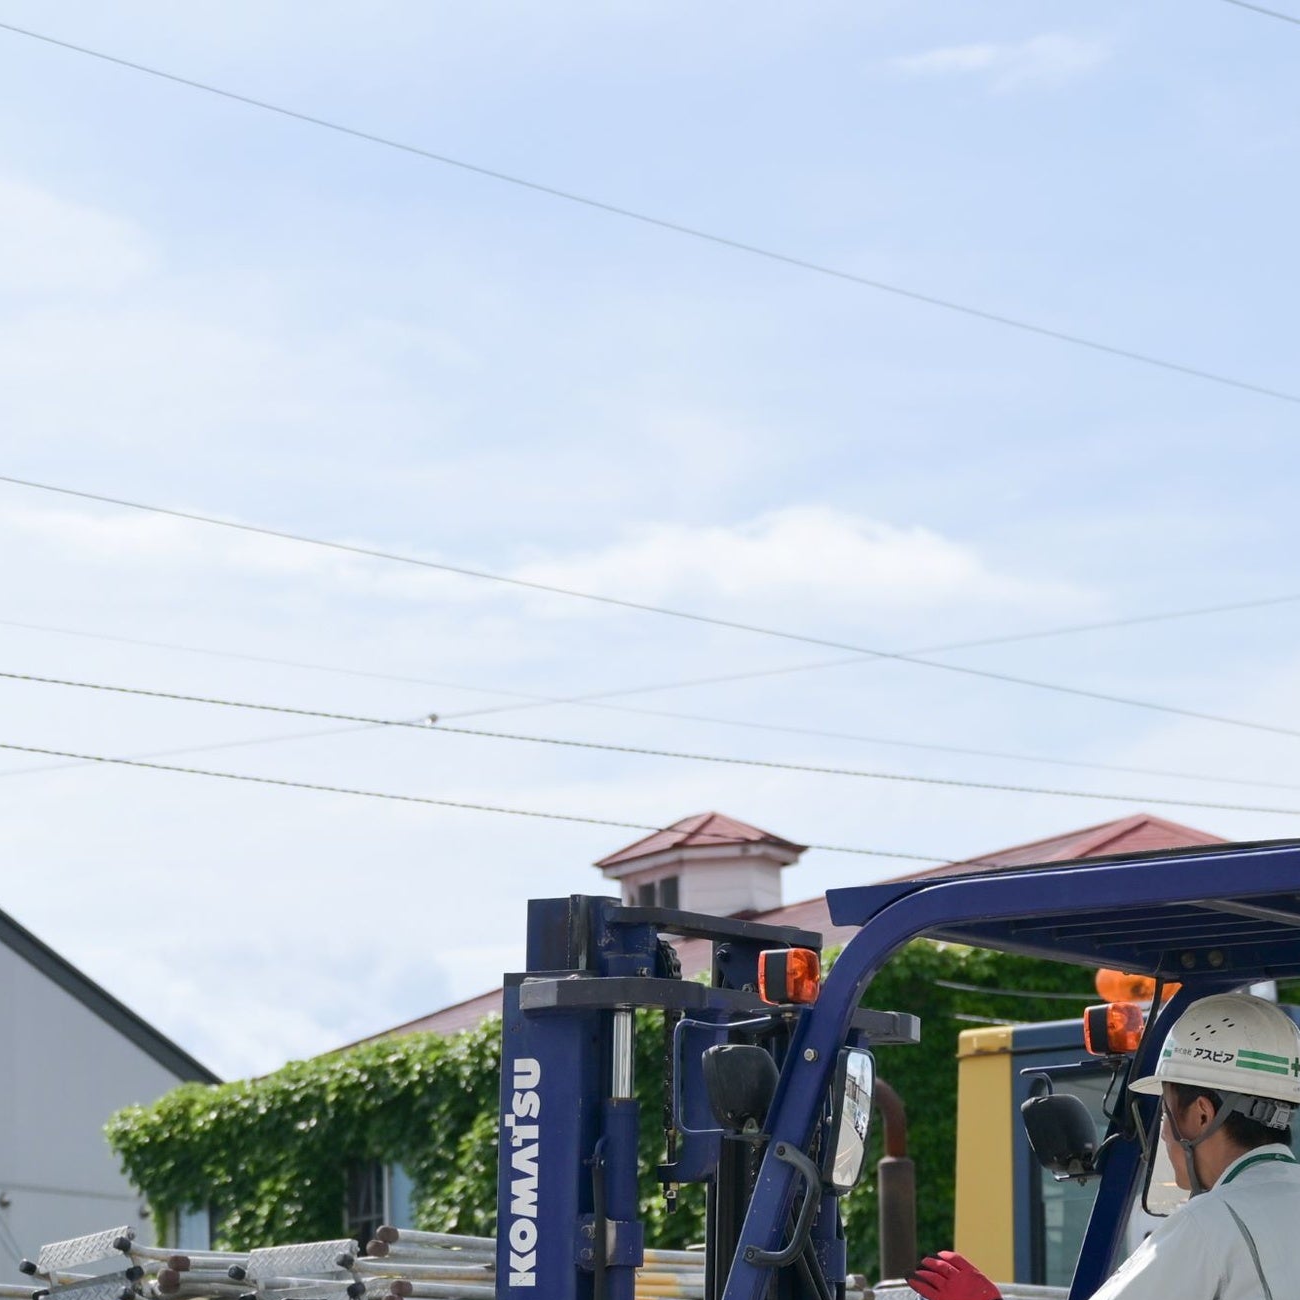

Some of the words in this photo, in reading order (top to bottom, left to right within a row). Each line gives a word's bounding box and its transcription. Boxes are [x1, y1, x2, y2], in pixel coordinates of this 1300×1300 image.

[1194, 1048, 1234, 1063] アスピア
[505, 1058, 541, 1286] KOMATSU
